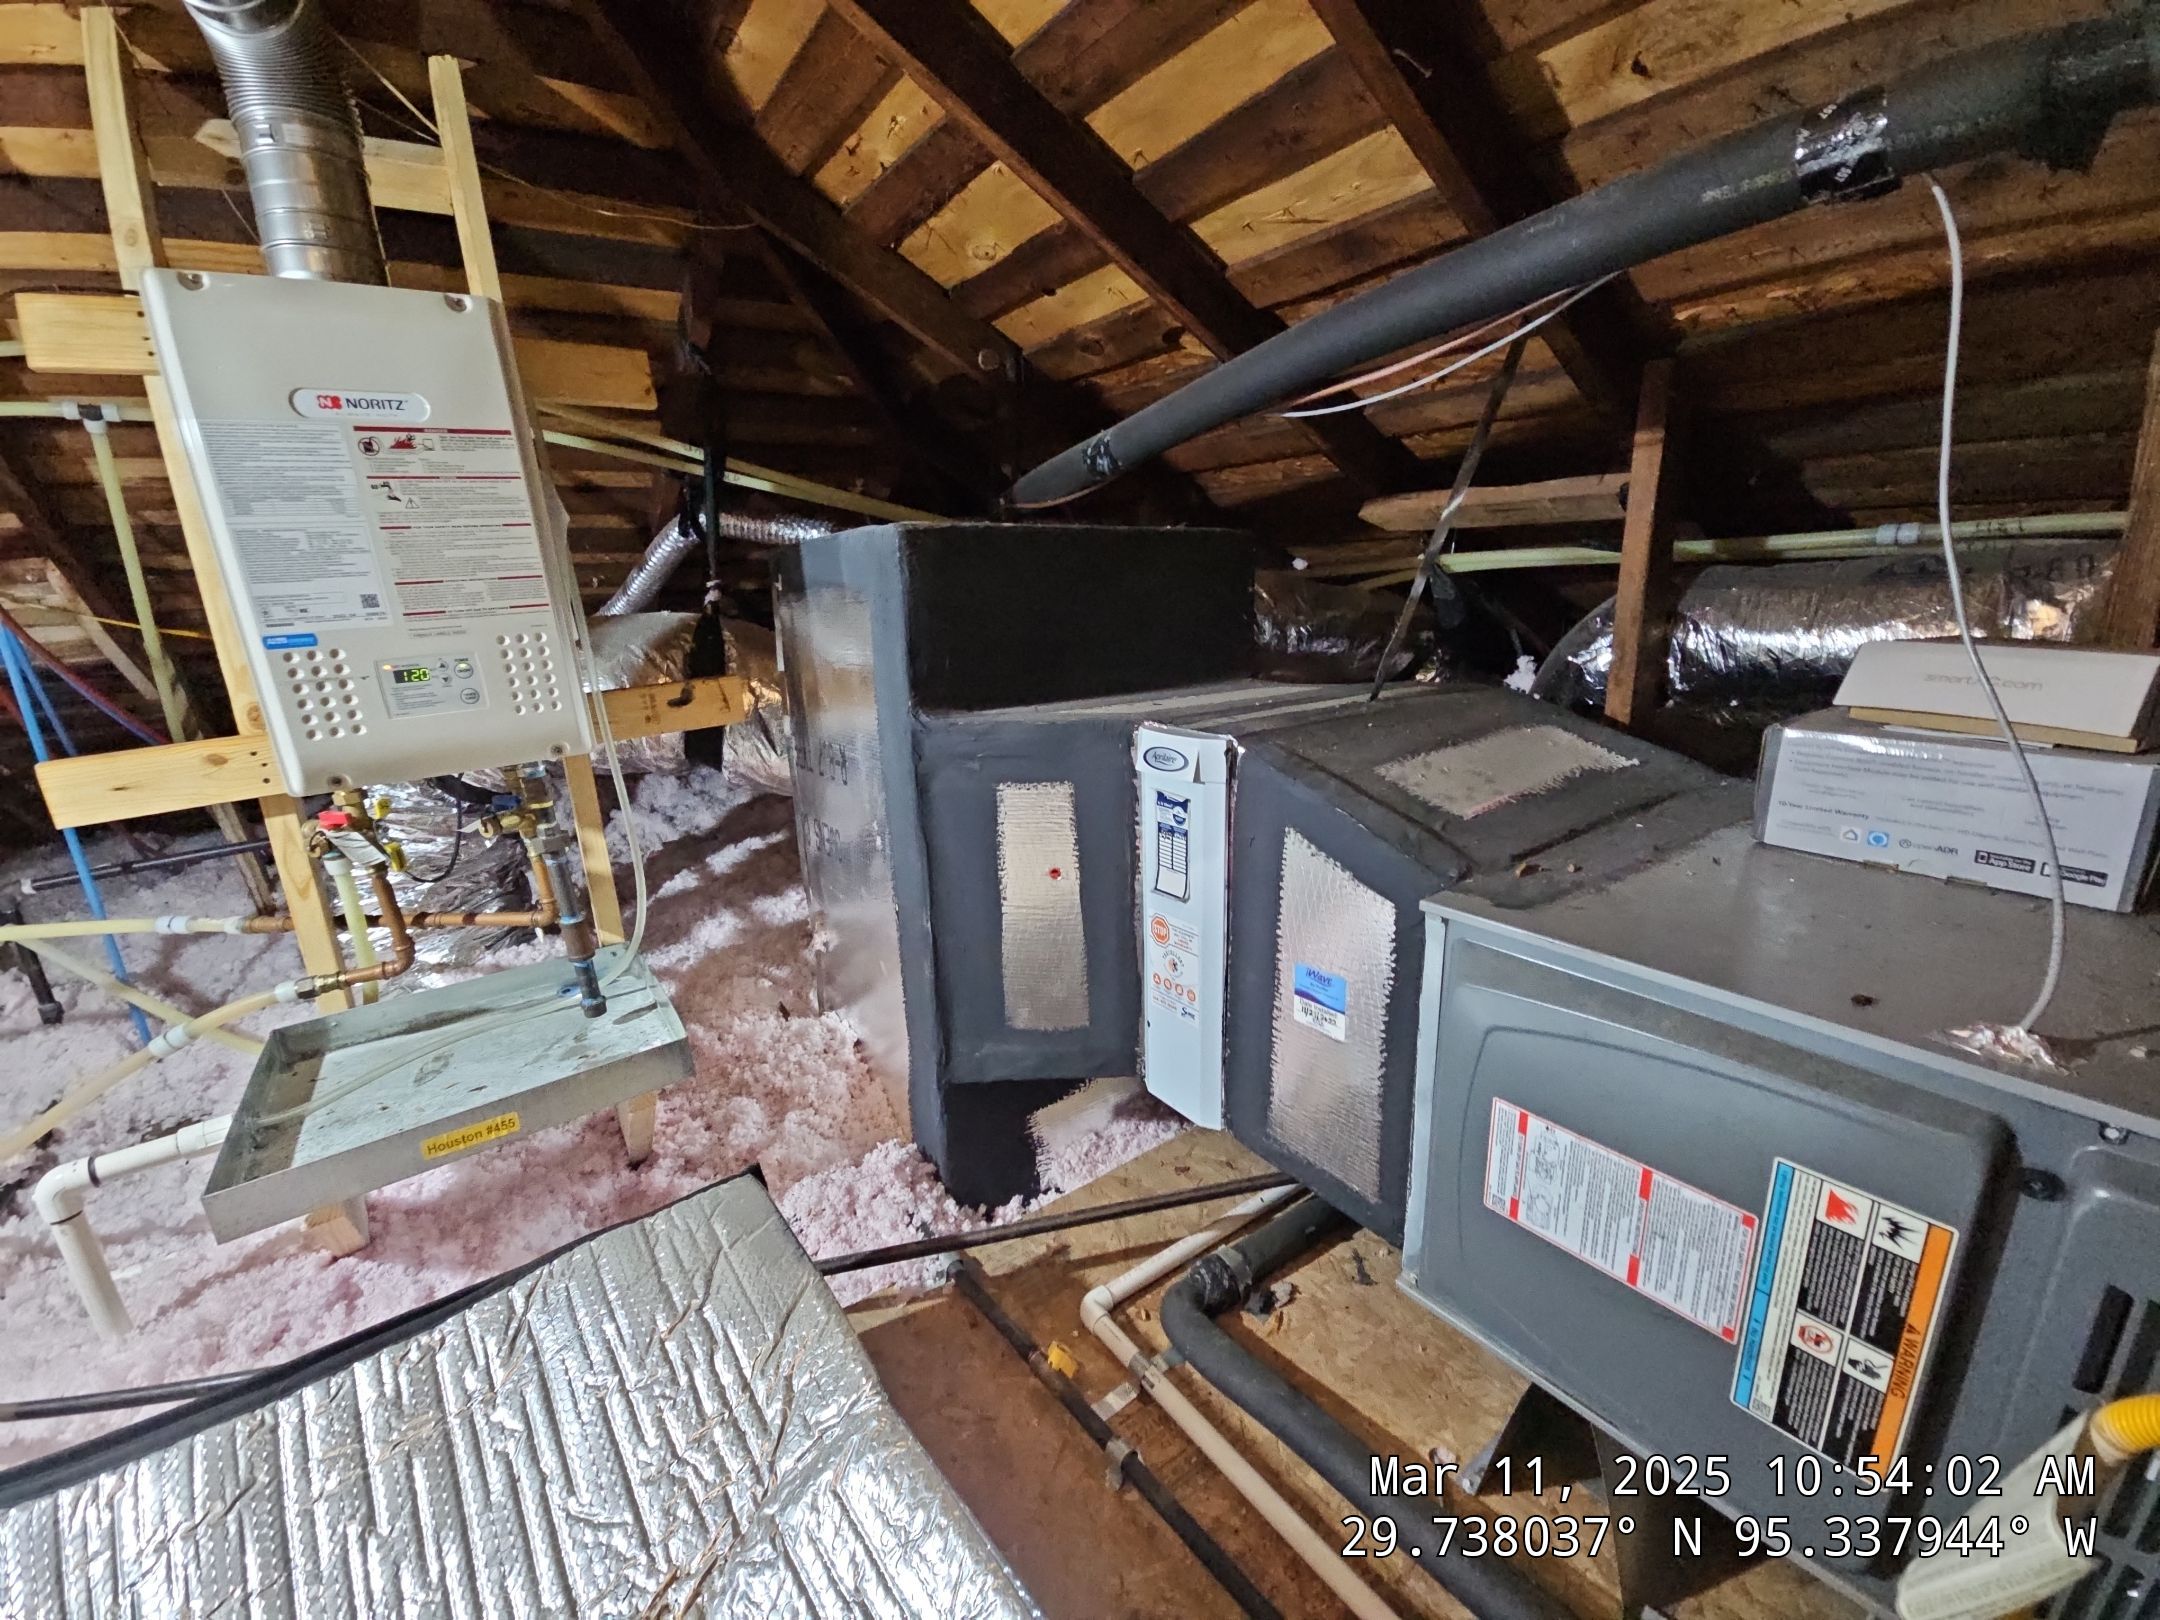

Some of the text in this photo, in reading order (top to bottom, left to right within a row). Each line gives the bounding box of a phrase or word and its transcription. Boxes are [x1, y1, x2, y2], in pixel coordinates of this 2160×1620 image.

[345, 398, 405, 411] NORITZ
[403, 668, 431, 682] 120
[426, 1118, 516, 1155] Houston #455
[1892, 1337, 1919, 1400] WARNING
